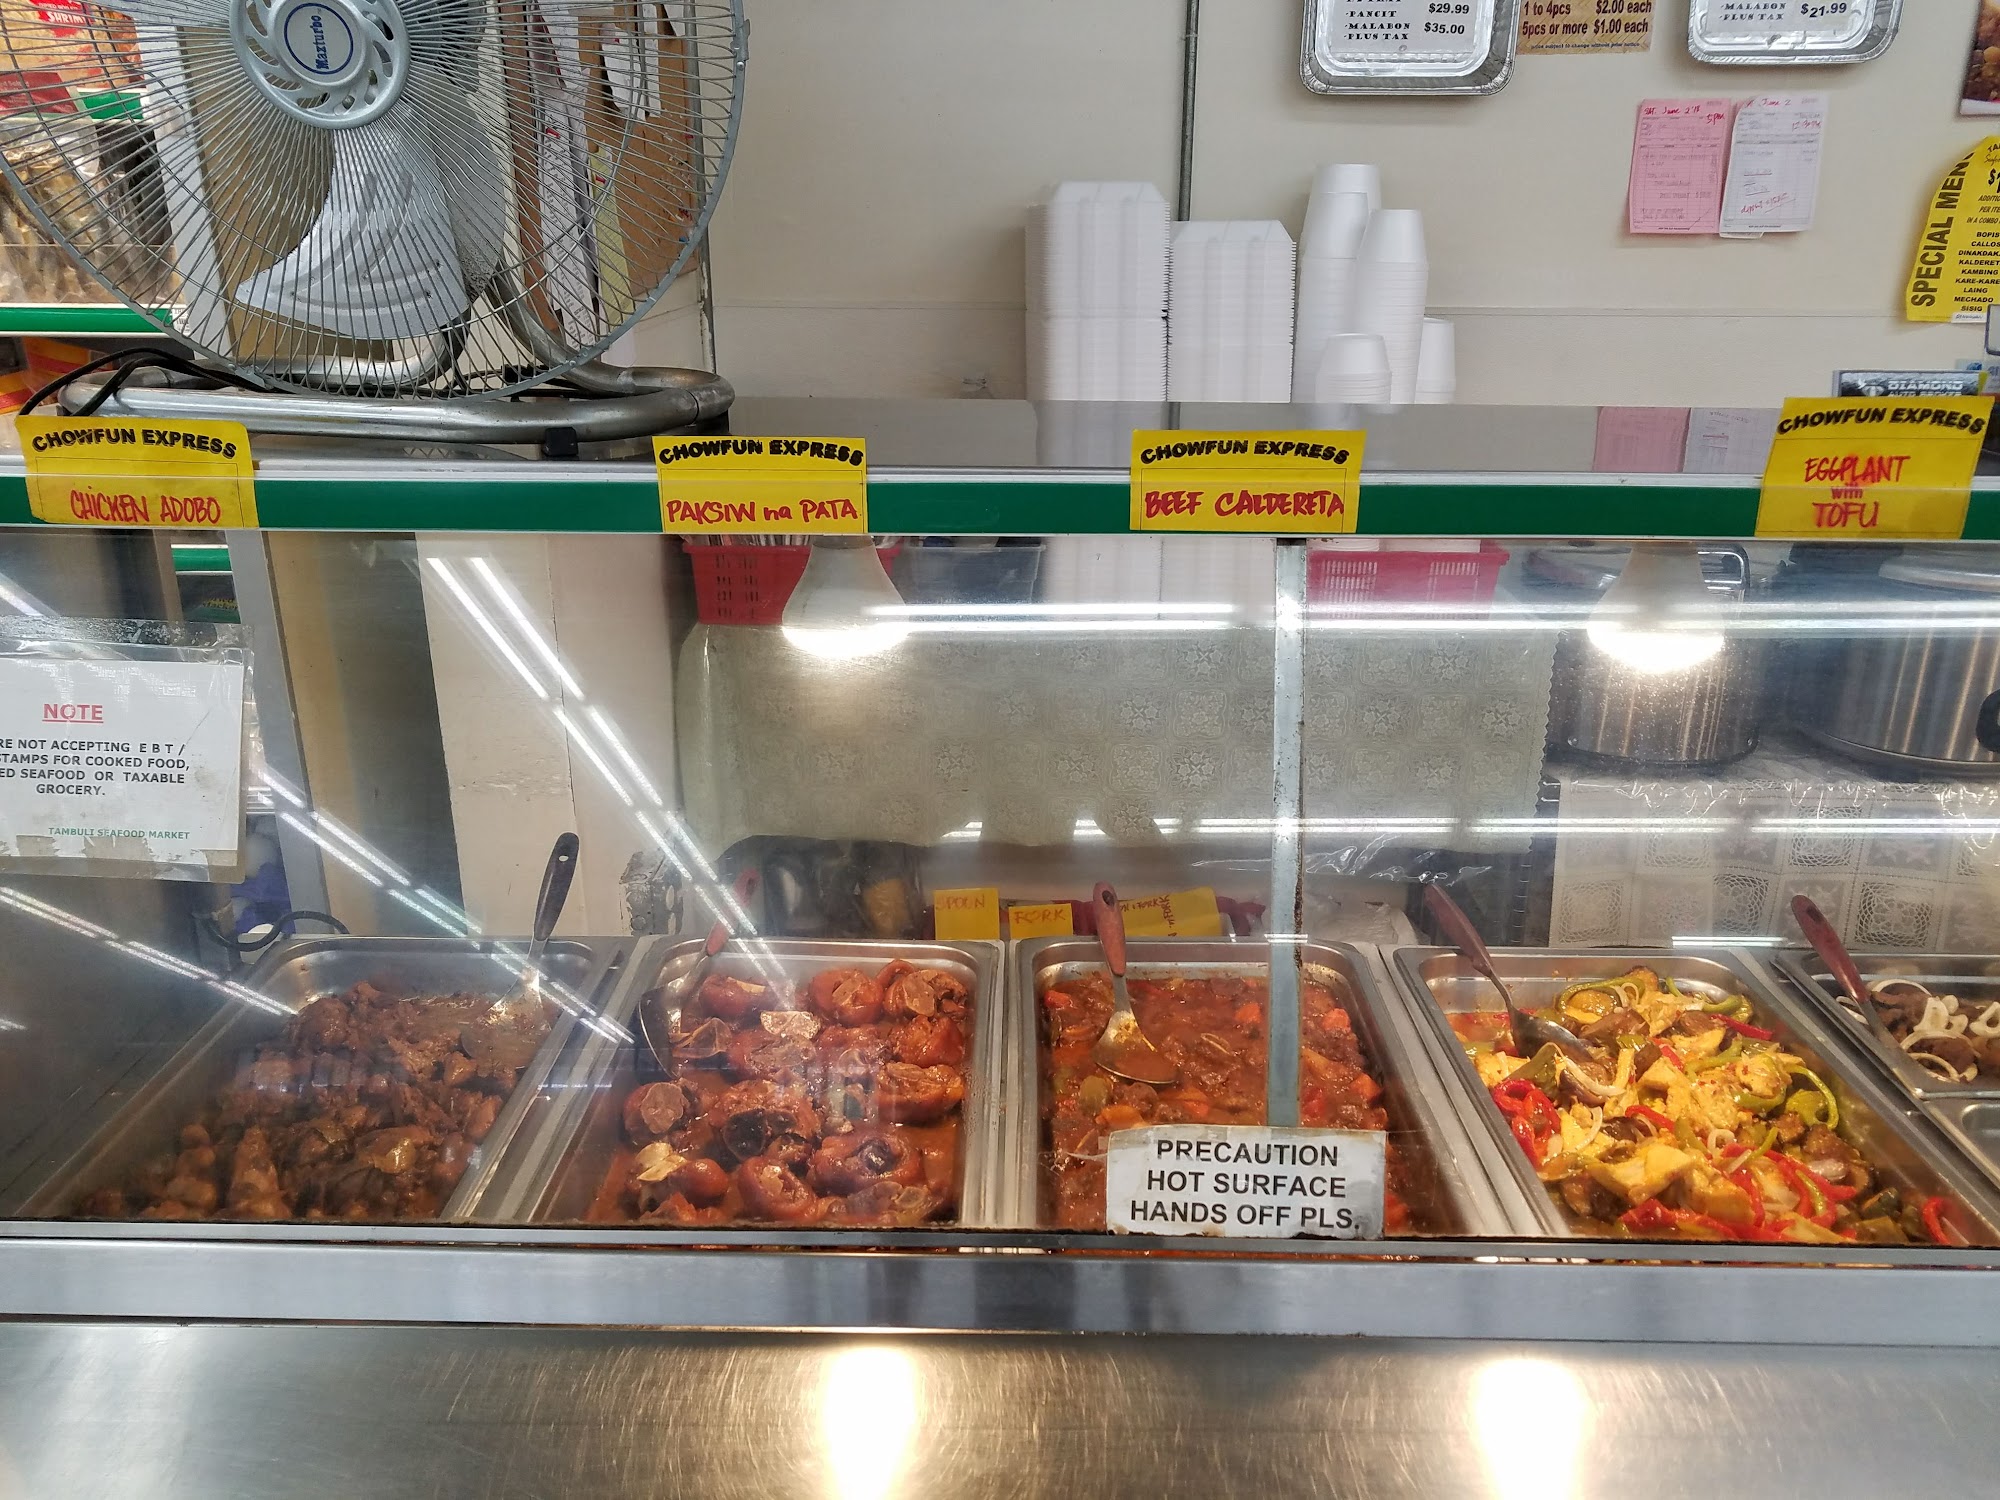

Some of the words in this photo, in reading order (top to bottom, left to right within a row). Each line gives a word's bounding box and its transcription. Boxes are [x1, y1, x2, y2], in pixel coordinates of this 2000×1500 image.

[1429, 3, 1470, 14] $29.99
[1524, 1, 1529, 16] 1
[1533, 1, 1543, 15] to
[1546, 1, 1571, 18] 4pcs
[1596, 0, 1625, 15] $2.00
[1627, 0, 1652, 13] each
[1801, 3, 1847, 18] $21.99
[1424, 22, 1465, 34] $35.00
[1522, 21, 1546, 39] 5pcs
[1549, 24, 1559, 35] or
[1562, 22, 1588, 35] more
[1593, 19, 1621, 35] $1.00
[1624, 18, 1649, 33] each
[1911, 216, 1954, 307] SPECIAL
[1936, 152, 1975, 209] MEN
[1888, 380, 1963, 390] DIAMOND
[1777, 407, 1887, 435] CHOWFUN
[1889, 407, 1985, 435] EXPRESS
[31, 428, 136, 452] CHOWFUN
[142, 429, 237, 459] EXPRESS
[659, 439, 763, 464] CHOWFUN
[769, 439, 864, 466] EXPRESS
[1140, 440, 1248, 464] CHOWFUN
[1254, 440, 1349, 464] EXPRESS
[1804, 455, 1911, 483] EGGPLANT
[1831, 482, 1863, 500] with
[70, 485, 149, 522] CHICKEN
[160, 495, 221, 524] ADOBO
[666, 500, 755, 524] PAKSIW
[764, 505, 792, 521] na
[799, 499, 858, 523] PATA
[1145, 490, 1204, 518] BEEF
[1215, 490, 1344, 518] CALDERETA
[1812, 501, 1879, 529] TOFU
[43, 703, 104, 721] NOTE
[18, 739, 47, 750] NOT
[50, 740, 130, 753] ACCEPTING
[0, 753, 49, 765] TAMPS
[53, 755, 81, 766] FOR
[85, 756, 142, 768] COOKED
[147, 757, 190, 771] FOOD,
[20, 769, 86, 780] SEAFOOD
[94, 771, 114, 781] OR
[123, 771, 185, 784] TAXABLE
[36, 783, 106, 796] GROCERY.
[48, 827, 95, 837] TAMBULI
[97, 828, 146, 838] SEAFOOD
[149, 830, 190, 840] MARKET
[1014, 908, 1066, 924] FORK
[1157, 1139, 1339, 1167] PRECAUTION
[1147, 1170, 1205, 1192] HOT
[1213, 1172, 1347, 1198] SURFACE
[1130, 1200, 1228, 1224] HANDS
[1236, 1203, 1292, 1227] OFF
[1300, 1207, 1360, 1230] PLS.
